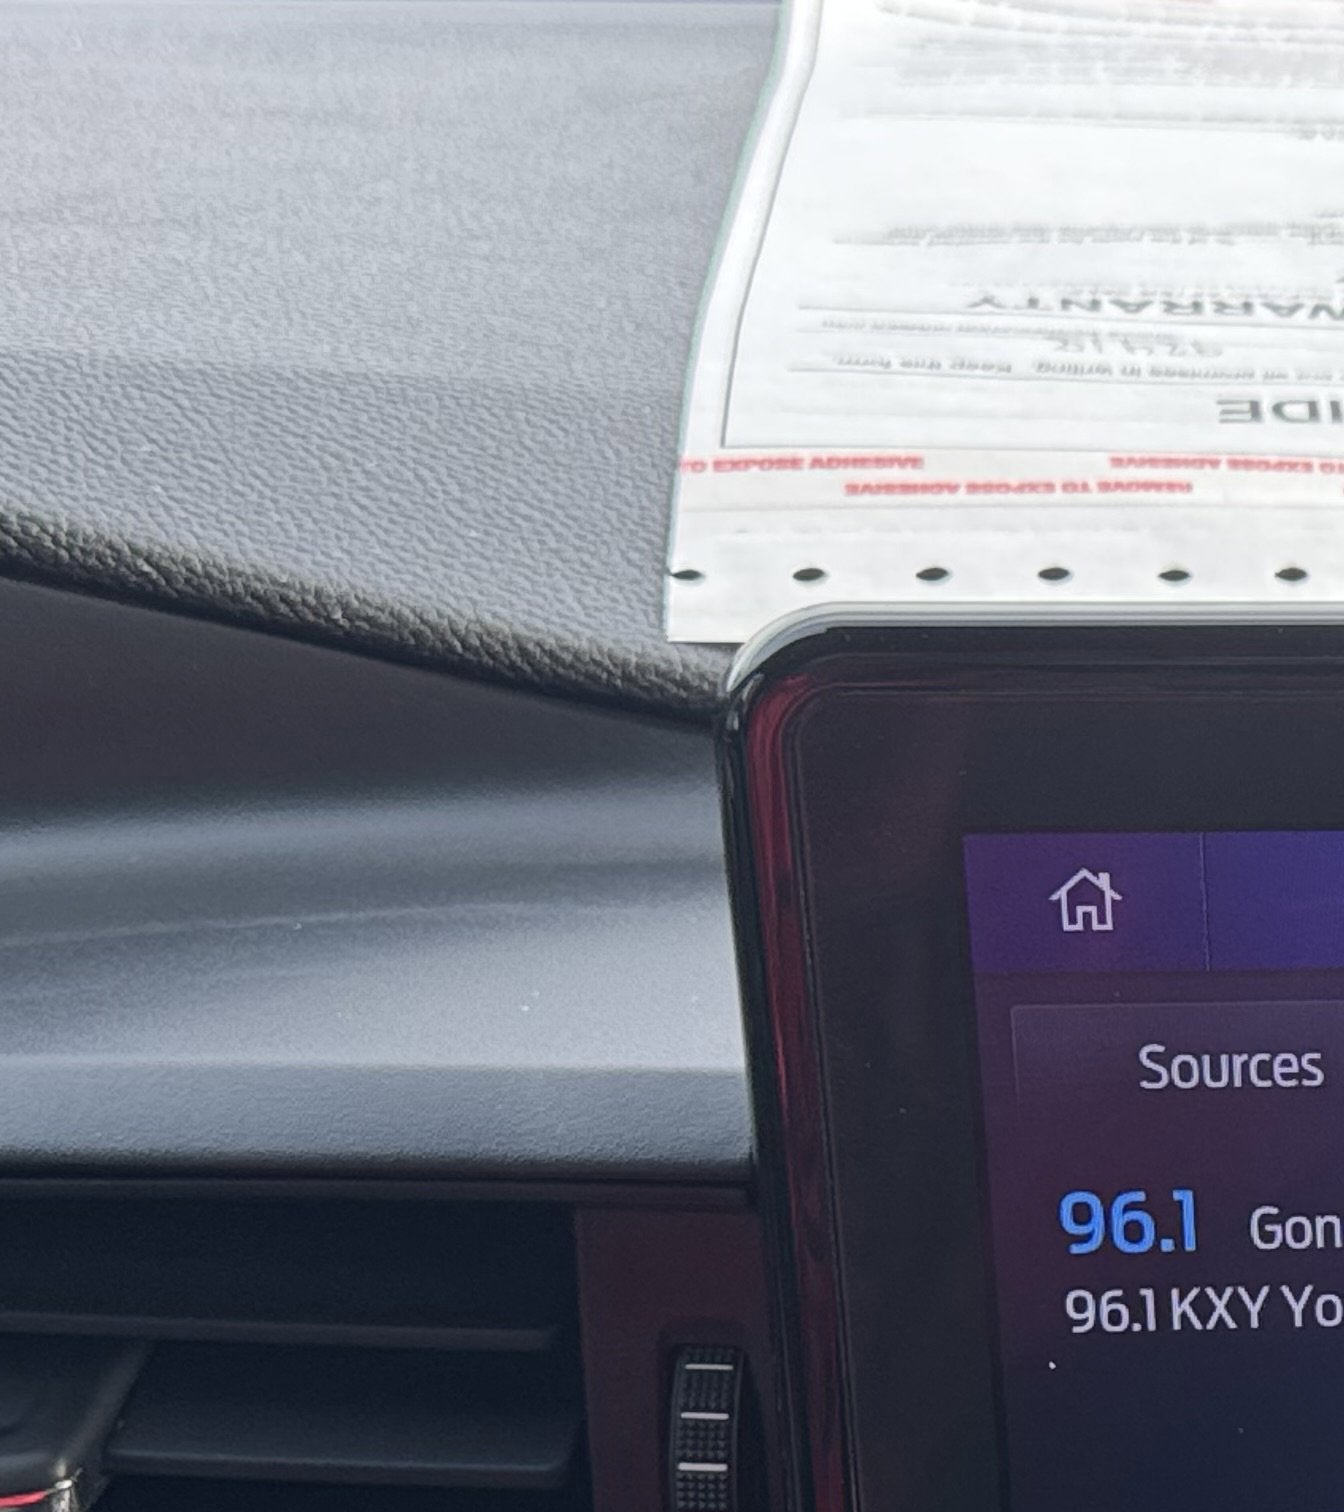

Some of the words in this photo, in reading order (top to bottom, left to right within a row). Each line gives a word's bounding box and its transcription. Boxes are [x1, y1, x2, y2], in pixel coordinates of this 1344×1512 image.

[1139, 1043, 1325, 1089] Sources
[1060, 1189, 1196, 1254] 96.1
[1065, 1288, 1157, 1334] 96.1
[1170, 1285, 1270, 1331] KXY
